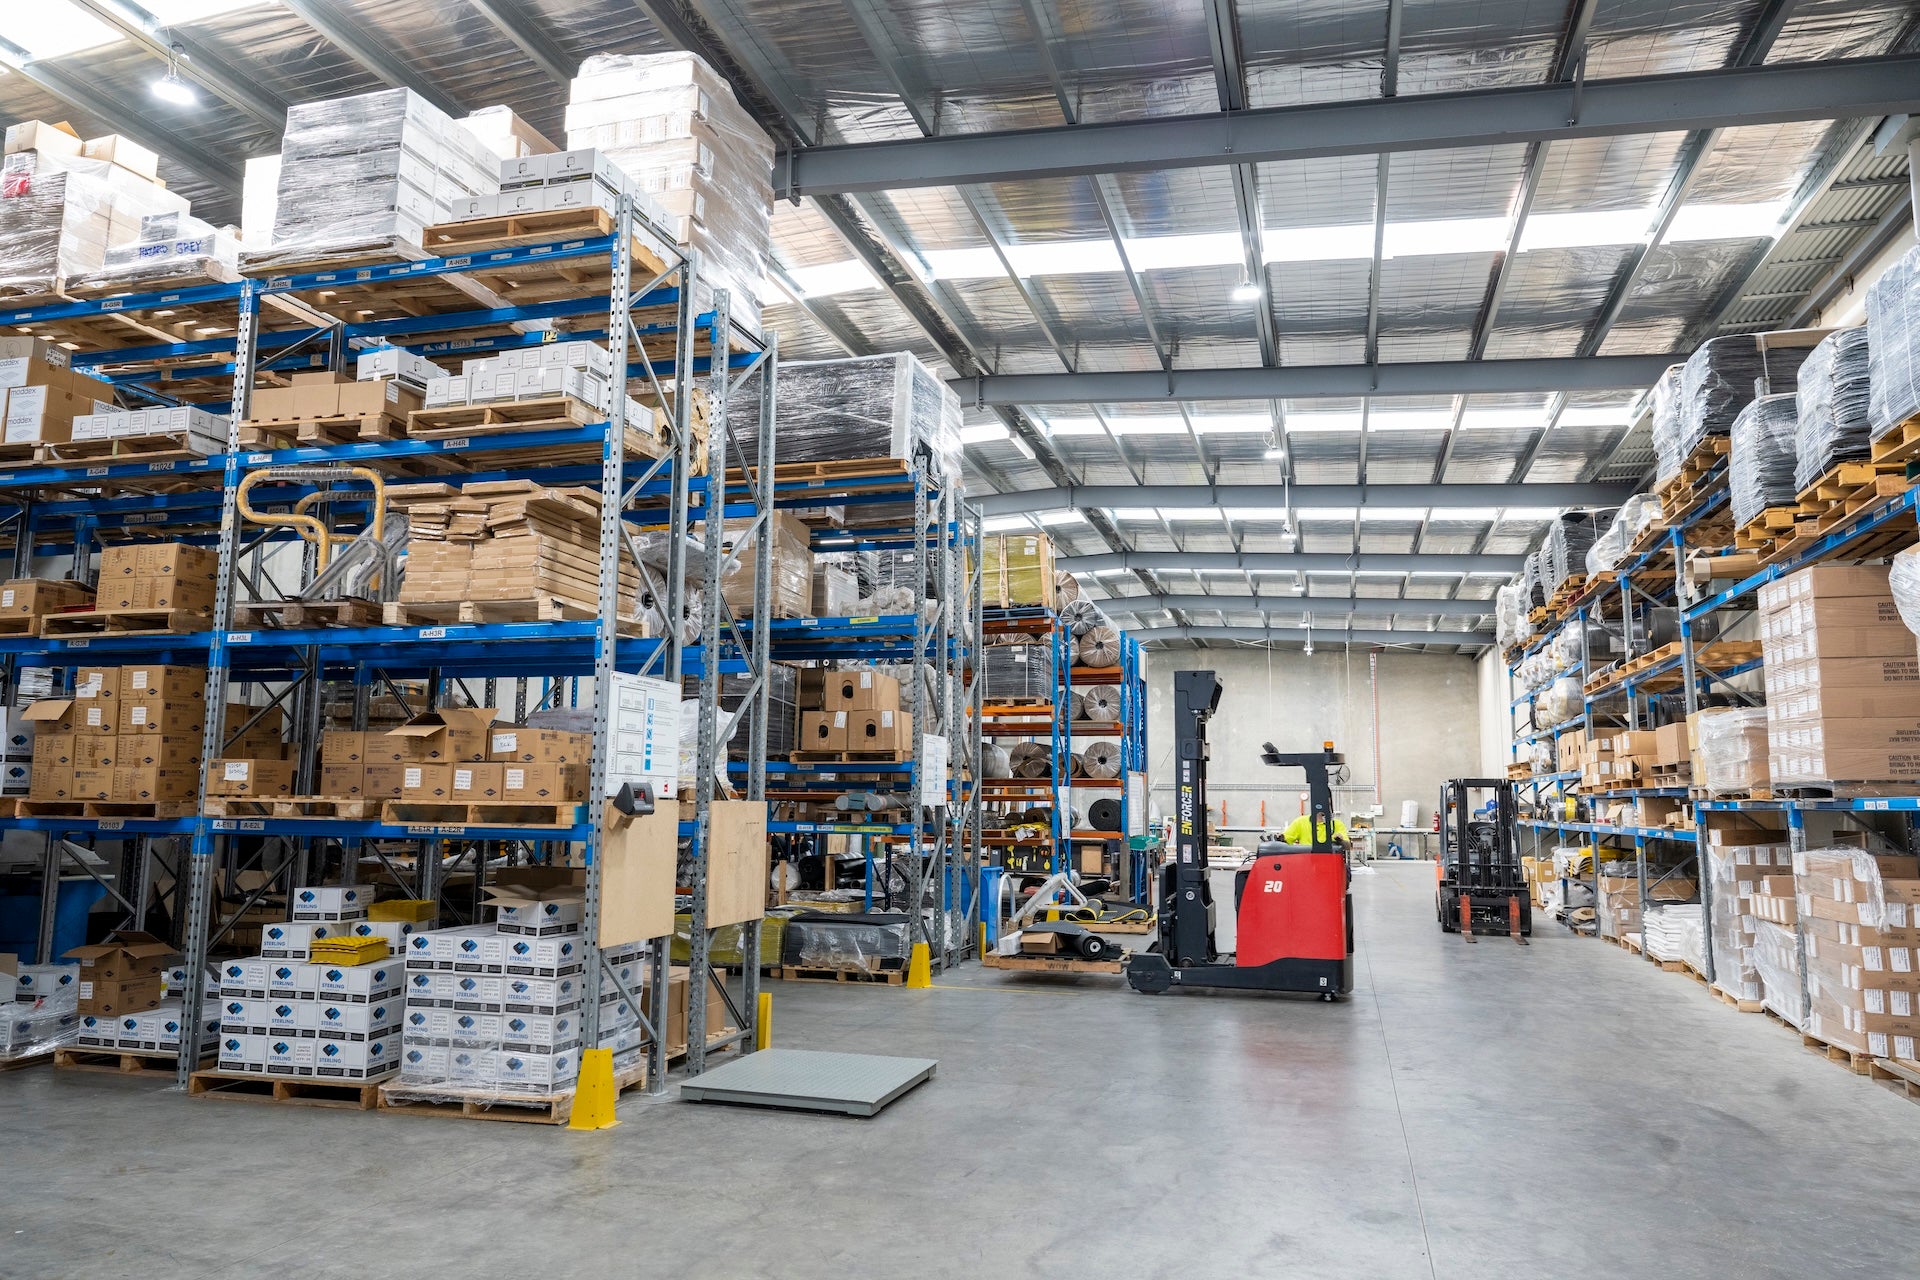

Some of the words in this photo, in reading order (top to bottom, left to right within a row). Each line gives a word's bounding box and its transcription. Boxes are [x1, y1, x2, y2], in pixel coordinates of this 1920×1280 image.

[176, 240, 202, 254] GREY
[11, 388, 36, 396] moddex
[446, 440, 466, 448] A-H4R
[1181, 785, 1192, 836] ENFORCER
[1264, 880, 1283, 893] 20
